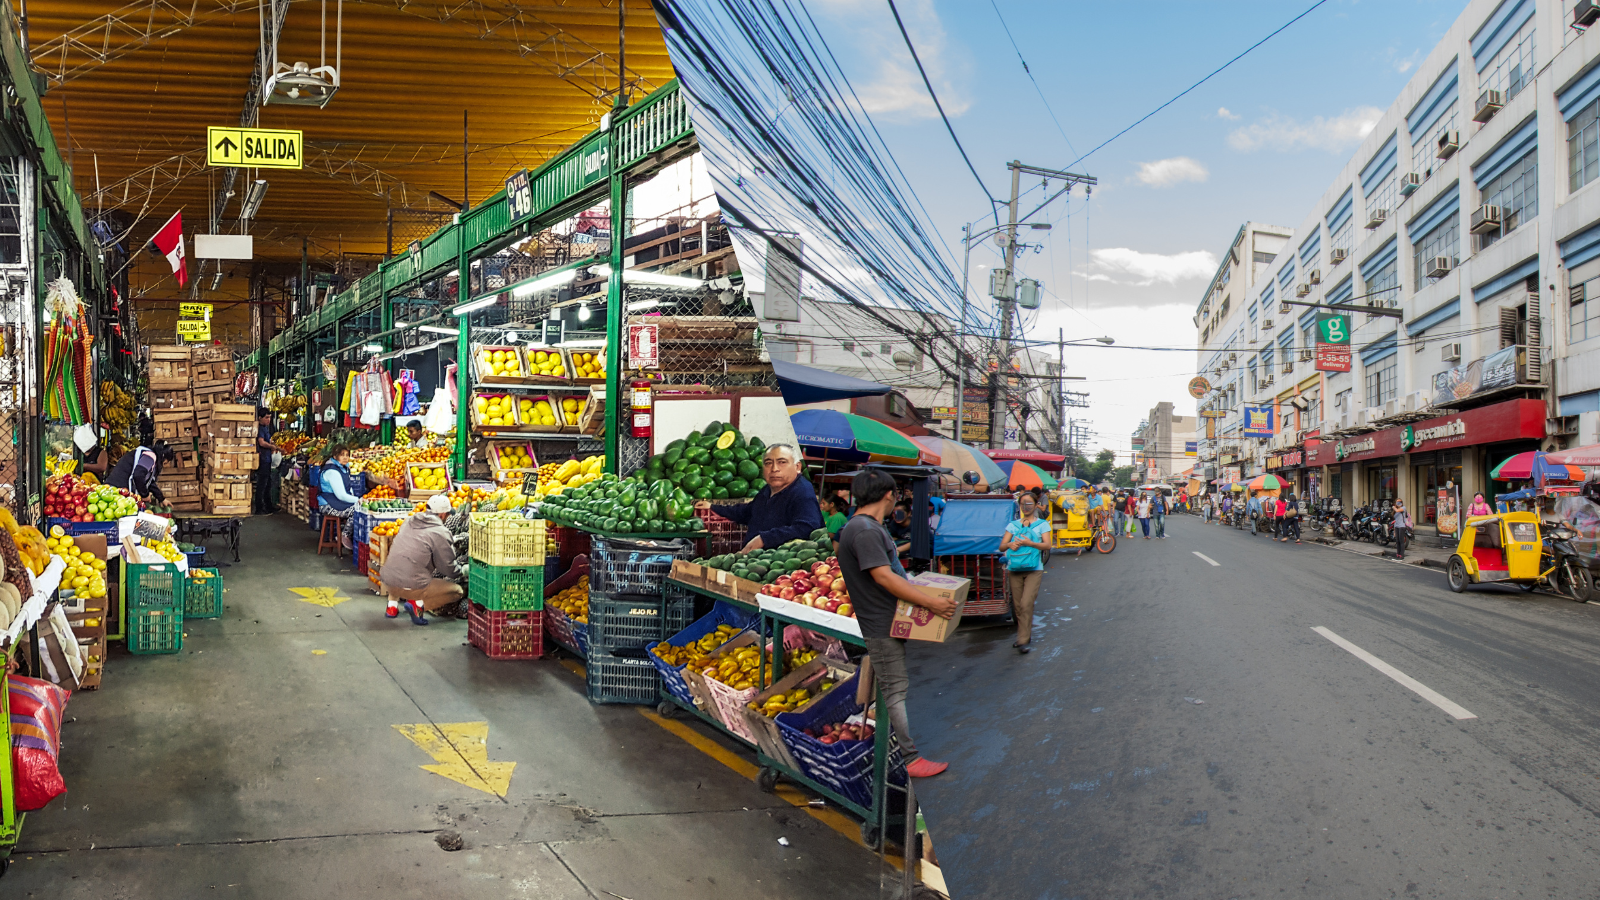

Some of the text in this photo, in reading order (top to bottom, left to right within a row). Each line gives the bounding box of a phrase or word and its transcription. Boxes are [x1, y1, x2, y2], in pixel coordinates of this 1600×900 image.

[245, 137, 296, 160] SALIDA
[515, 186, 531, 217] 46
[179, 323, 198, 332] SALIDA
[1327, 317, 1344, 342] g
[1318, 353, 1350, 363] 5-55-55
[1322, 361, 1346, 369] delivery
[1414, 418, 1466, 447] greenwich
[1267, 456, 1282, 469] KING
[1283, 451, 1302, 467] SISIG
